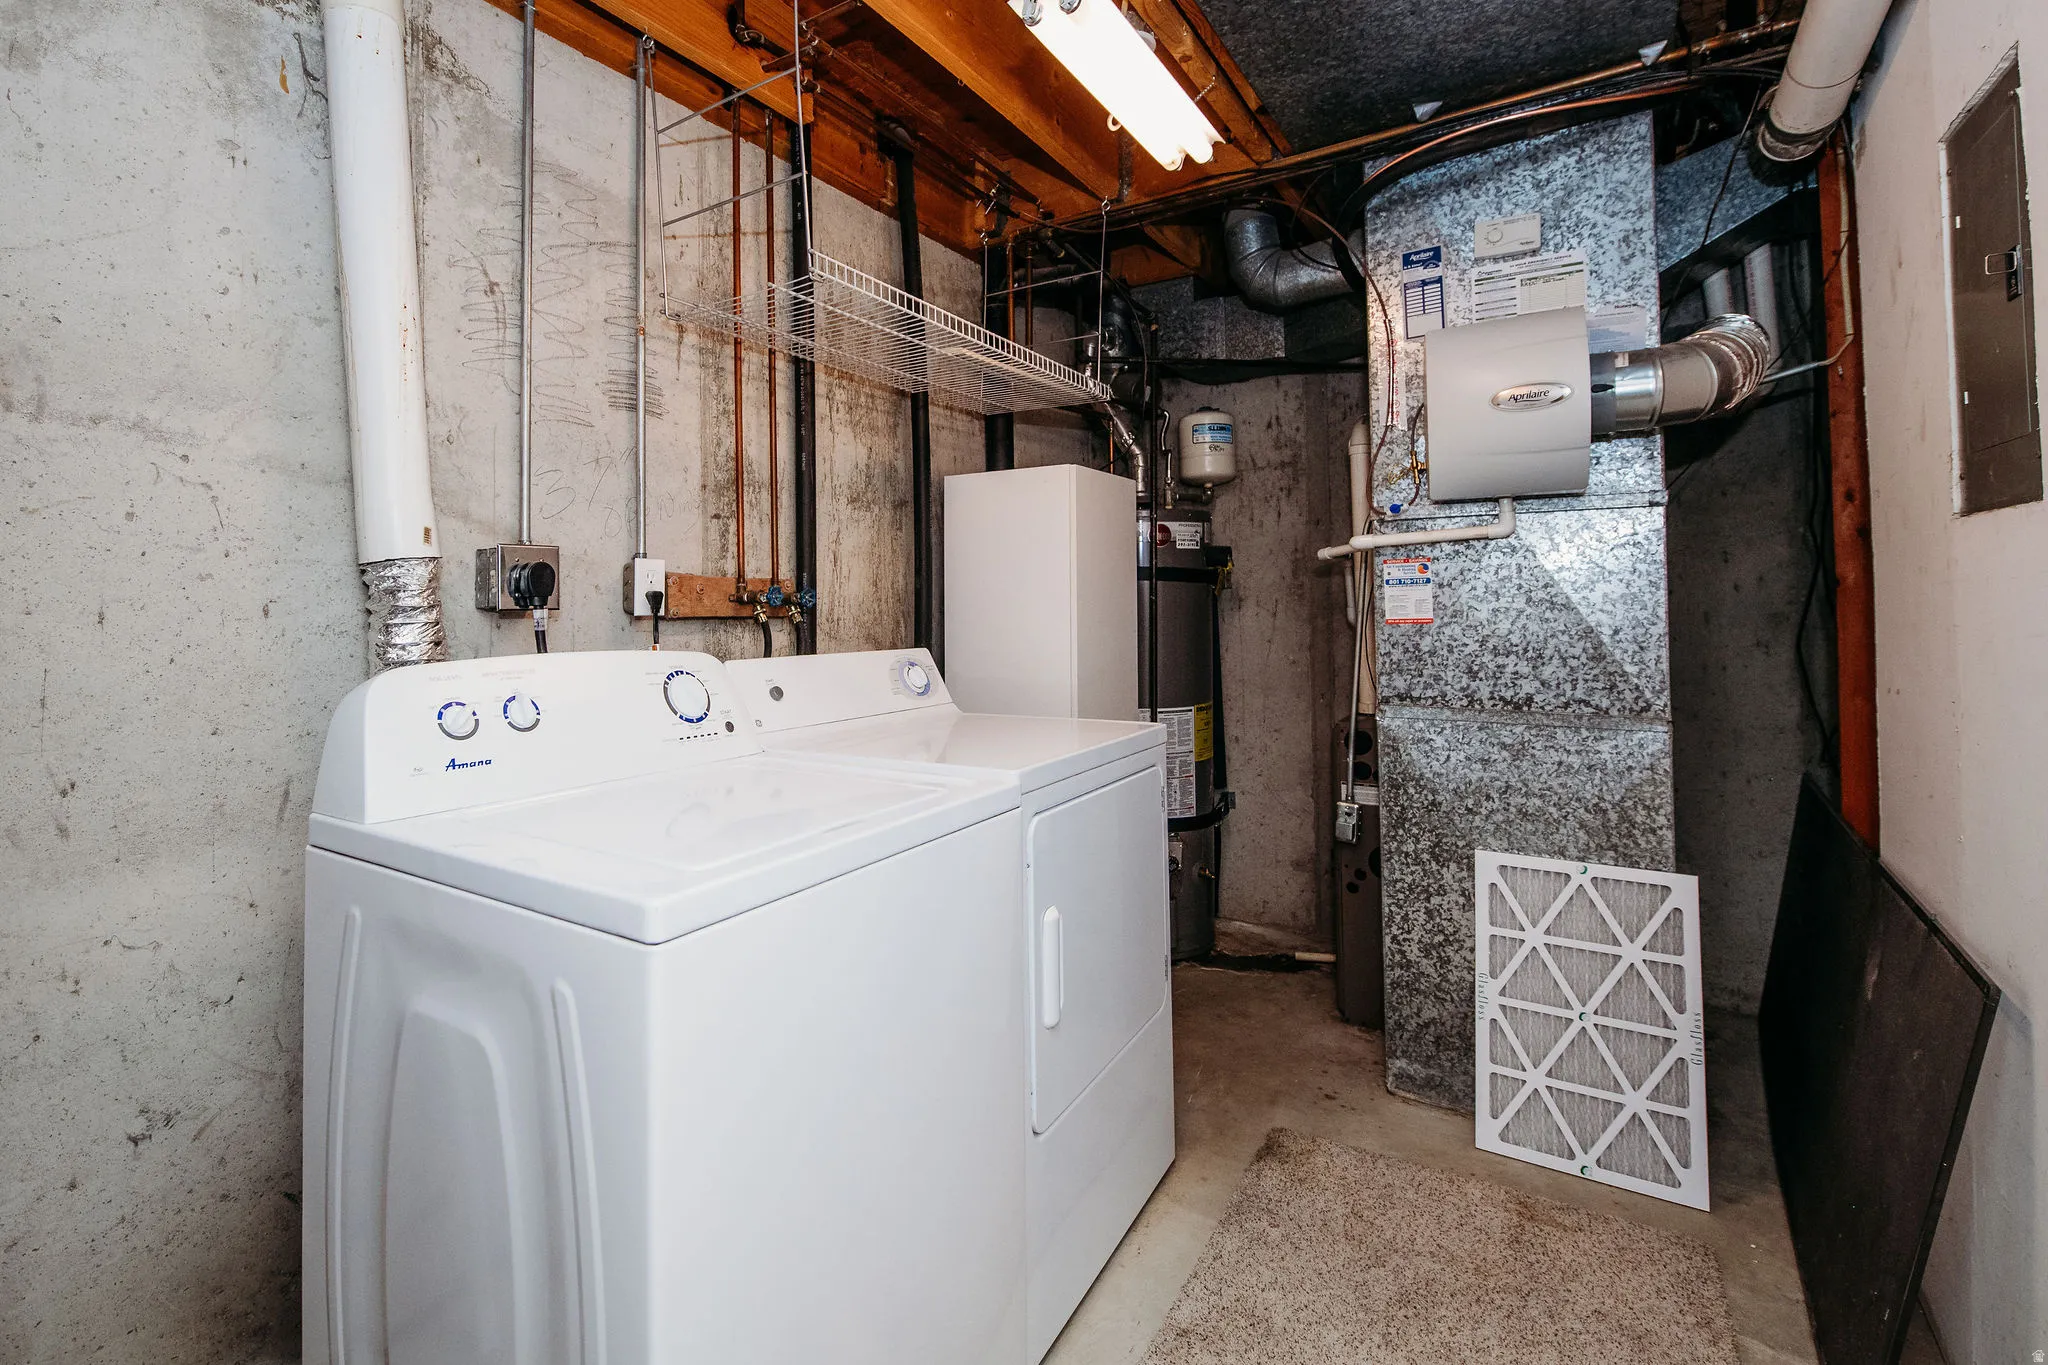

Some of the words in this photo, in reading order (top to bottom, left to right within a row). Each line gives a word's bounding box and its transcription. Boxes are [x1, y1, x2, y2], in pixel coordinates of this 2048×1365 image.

[1409, 251, 1434, 262] Aprilaire
[1507, 389, 1550, 404] Aprilaire
[445, 757, 493, 772] Amana
[1477, 972, 1489, 1020] Glasfloss
[1690, 1012, 1704, 1066] Glasfloss
